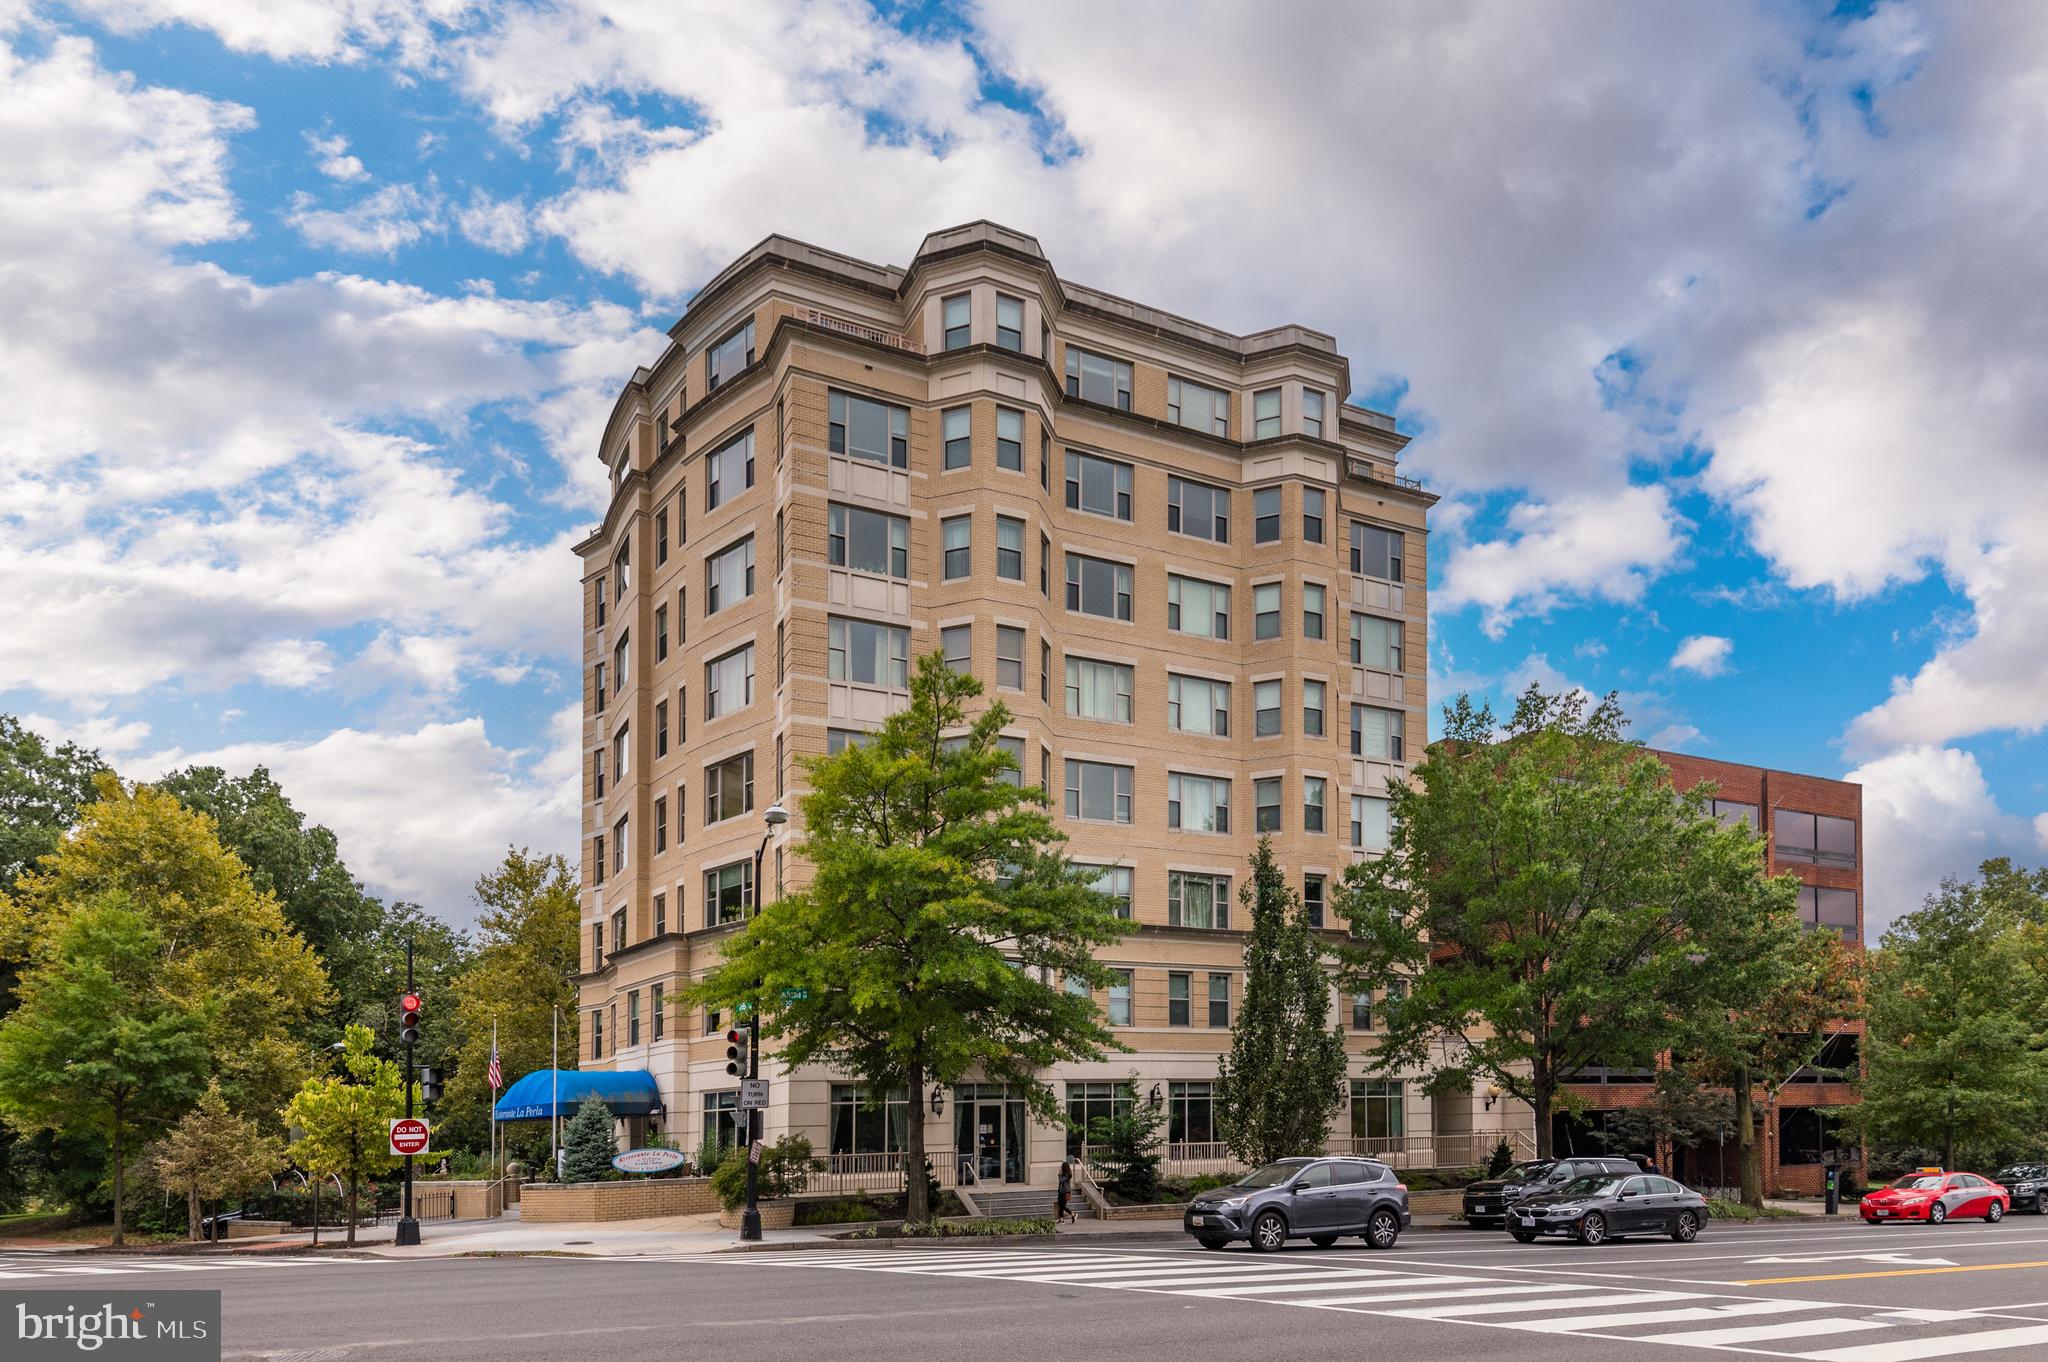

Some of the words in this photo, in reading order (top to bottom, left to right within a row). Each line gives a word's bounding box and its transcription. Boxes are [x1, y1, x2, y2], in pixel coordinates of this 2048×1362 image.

[516, 1107, 525, 1117] La
[525, 1105, 543, 1117] Perla
[618, 1151, 649, 1163] Ristorante
[663, 1151, 678, 1160] Perla
